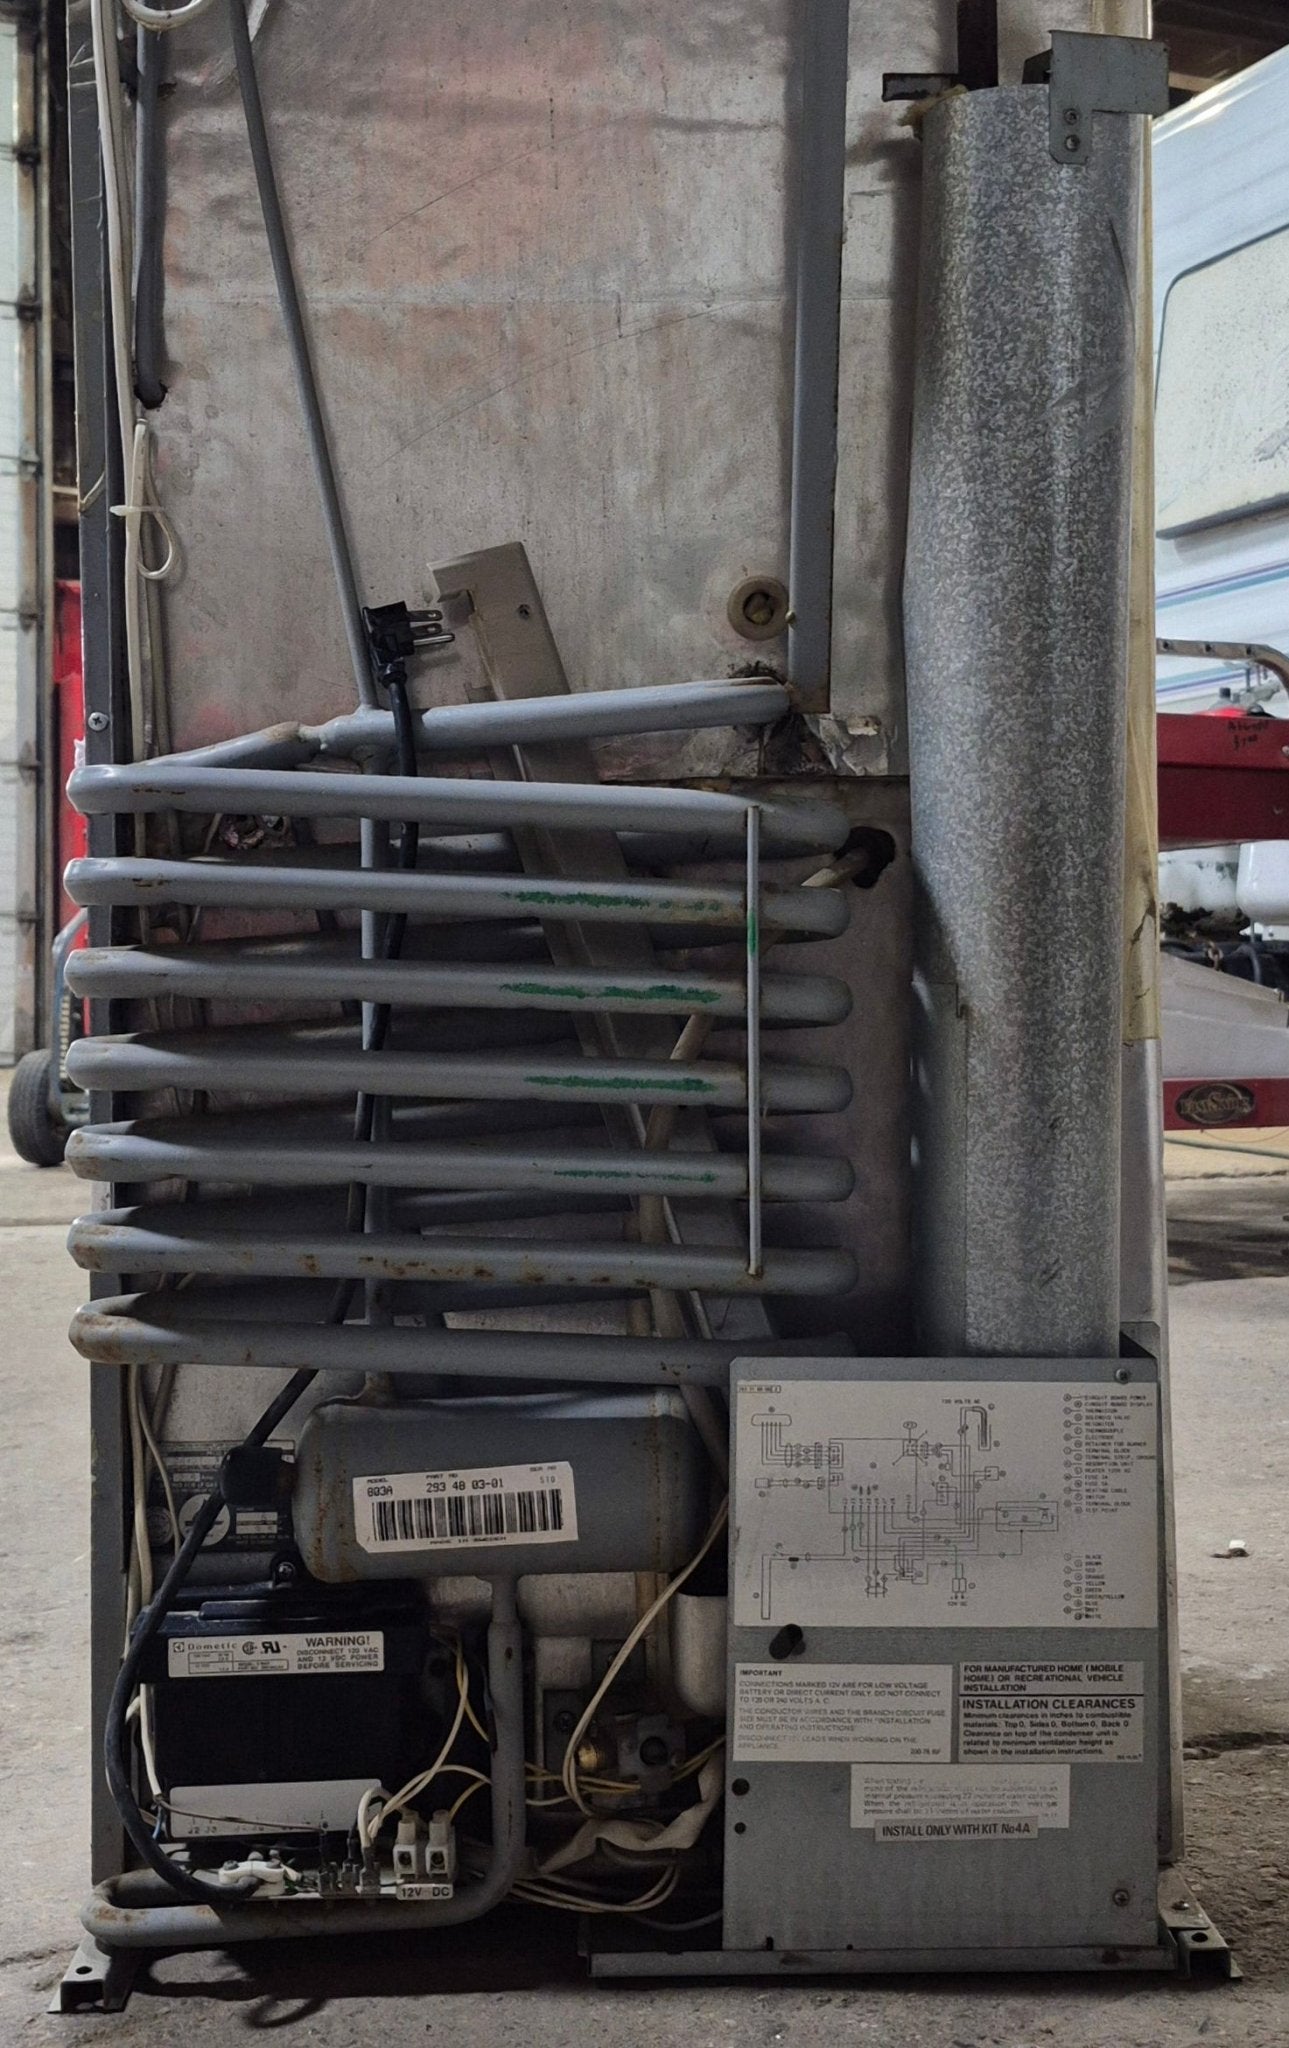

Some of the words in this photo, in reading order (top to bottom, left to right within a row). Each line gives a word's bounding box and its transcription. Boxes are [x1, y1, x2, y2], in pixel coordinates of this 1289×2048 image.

[426, 1482, 446, 1493] 293
[452, 1481, 466, 1492] 48
[472, 1478, 504, 1490] 03-01
[306, 1635, 371, 1647] WARNING!
[188, 1642, 237, 1651] Dometic
[296, 1648, 344, 1656] DISCONNECT
[297, 1662, 330, 1670] BEFORE
[335, 1660, 379, 1668] SERVICING
[964, 1664, 982, 1673] FOR
[984, 1664, 1055, 1673] MANUFACTURED
[1057, 1664, 1083, 1673] HOME
[964, 1674, 994, 1683] HOME)
[998, 1674, 1010, 1682] OR
[1014, 1674, 1083, 1682] RECREATIONAL
[1087, 1674, 1124, 1682] VEHICLE
[739, 1688, 772, 1696] BATTERY
[814, 1689, 849, 1697] CURRENT
[964, 1684, 1027, 1692] INSTALLATION
[962, 1698, 1049, 1710] INSTALLATION
[1052, 1698, 1136, 1710] CLEARANCES
[1005, 1721, 1018, 1729] Top
[1014, 1730, 1027, 1739] top
[1079, 1739, 1102, 1748] height
[963, 1748, 988, 1756] shown
[1014, 1748, 1056, 1756] installation
[882, 1825, 923, 1837] INSTALL
[925, 1824, 952, 1836] ONLY
[953, 1823, 981, 1836] WITH
[981, 1822, 998, 1835] KIT
[401, 1887, 422, 1898] 12V
[432, 1886, 451, 1897] DC
